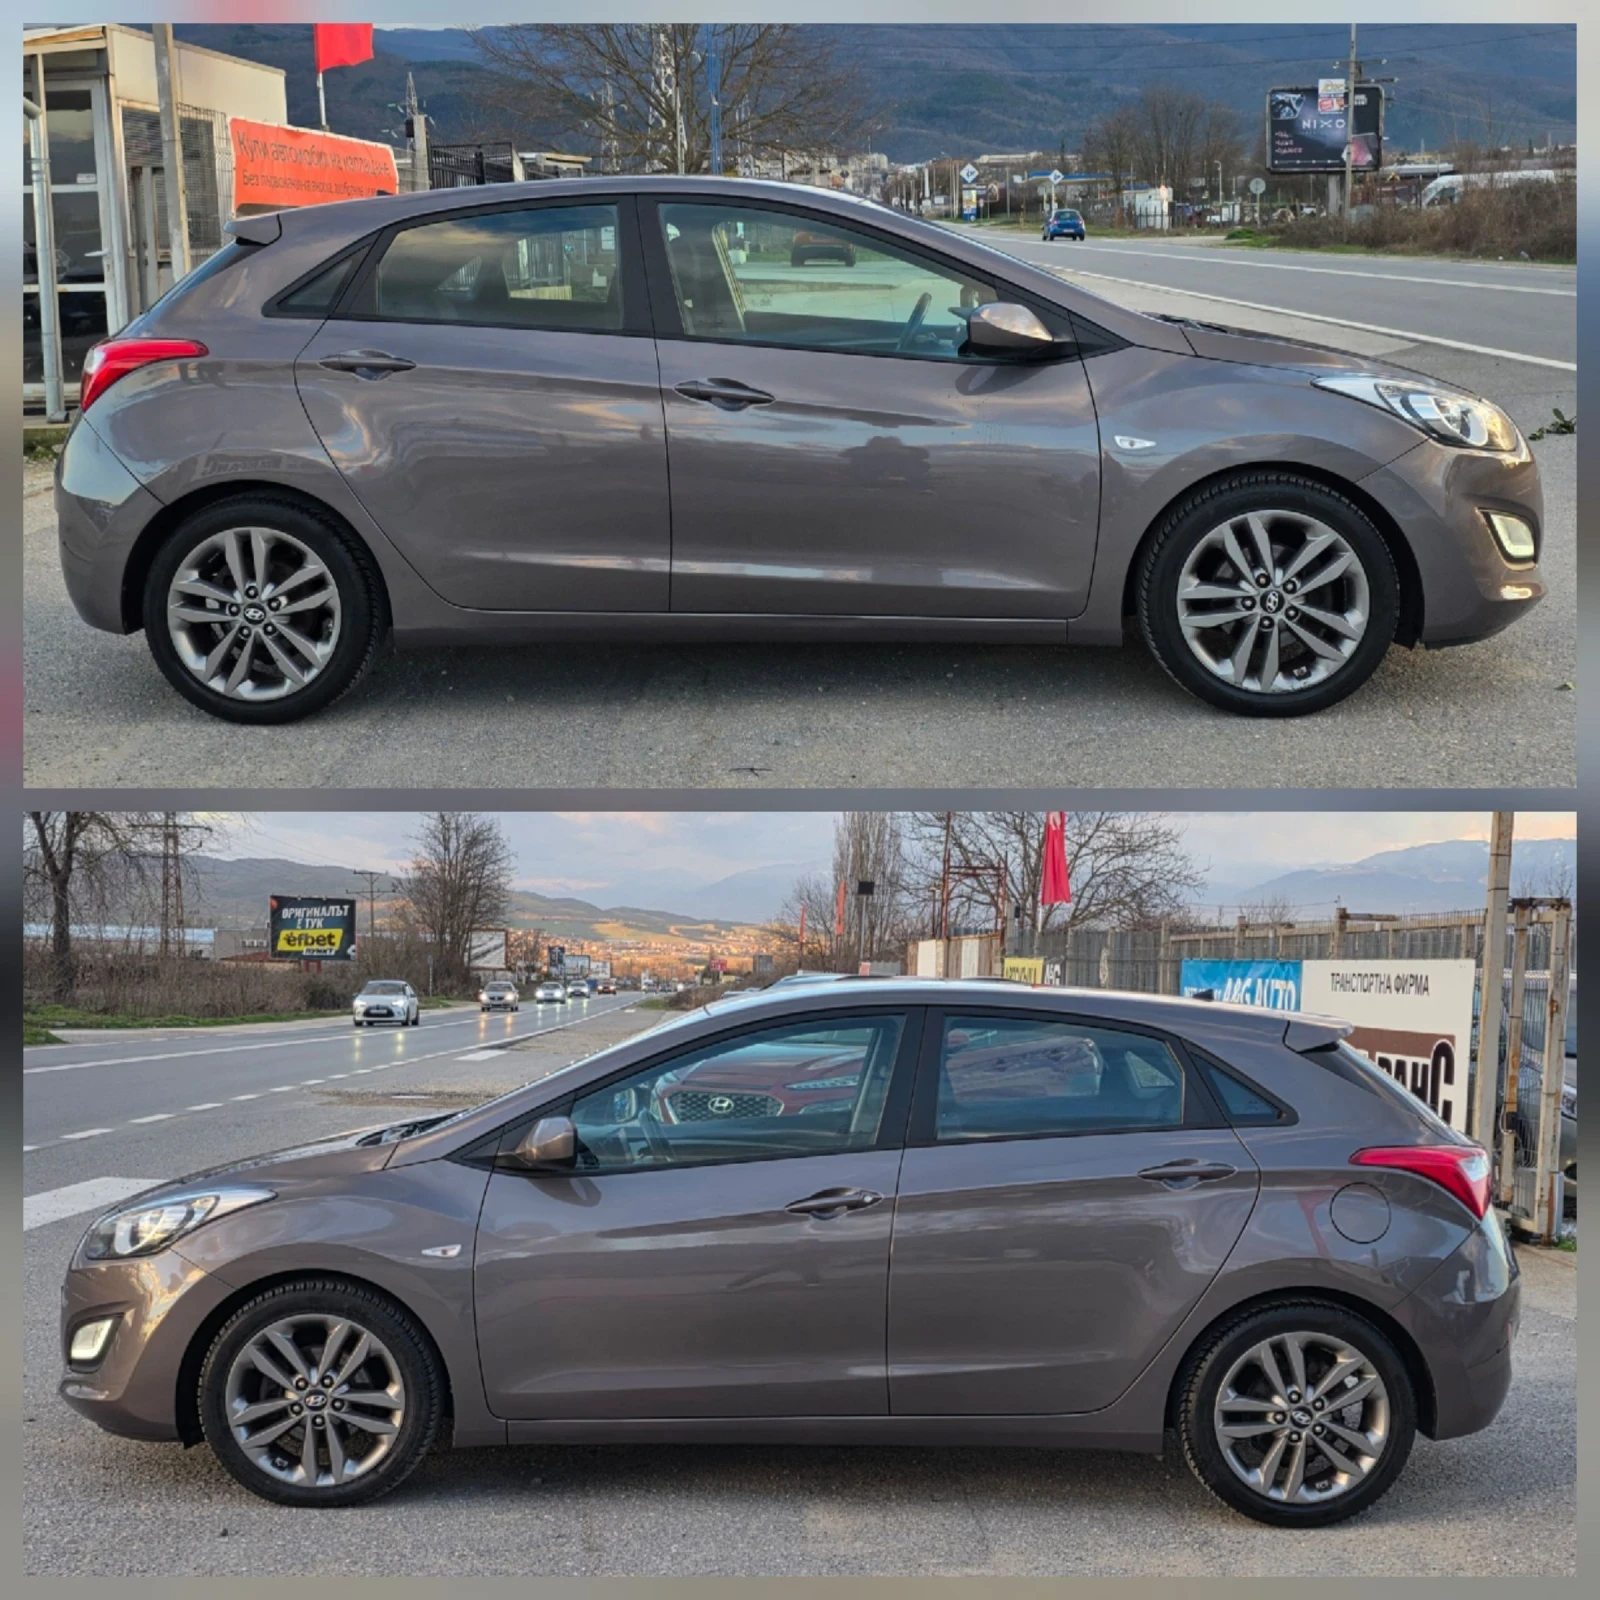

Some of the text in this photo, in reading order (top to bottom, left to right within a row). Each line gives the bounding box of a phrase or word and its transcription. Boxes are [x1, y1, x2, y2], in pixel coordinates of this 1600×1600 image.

[237, 130, 269, 163] Купи
[282, 905, 349, 918] ОРИГИНАЛЪТ
[305, 918, 324, 929] ТУК
[284, 932, 336, 947] efbet
[1330, 972, 1430, 996] ТРАНСПОРТНА ФИРМА
